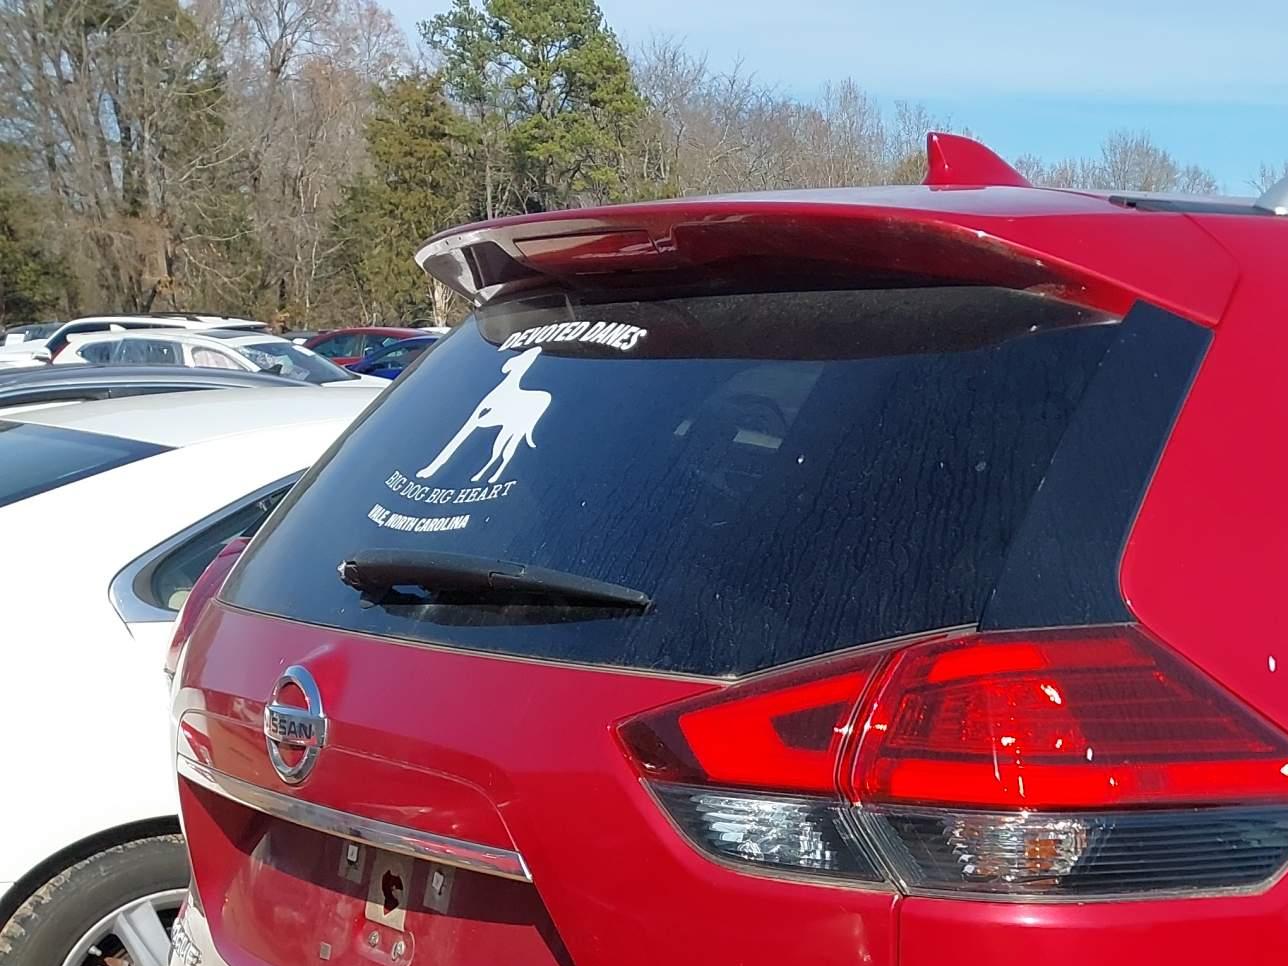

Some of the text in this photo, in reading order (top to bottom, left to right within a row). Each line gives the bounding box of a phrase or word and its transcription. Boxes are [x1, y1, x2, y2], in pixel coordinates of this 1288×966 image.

[498, 321, 647, 351] DEVOTED DANES
[385, 470, 517, 504] BIG DOG BIG HEART
[367, 503, 470, 532] VALE, NORTH CAROLINA
